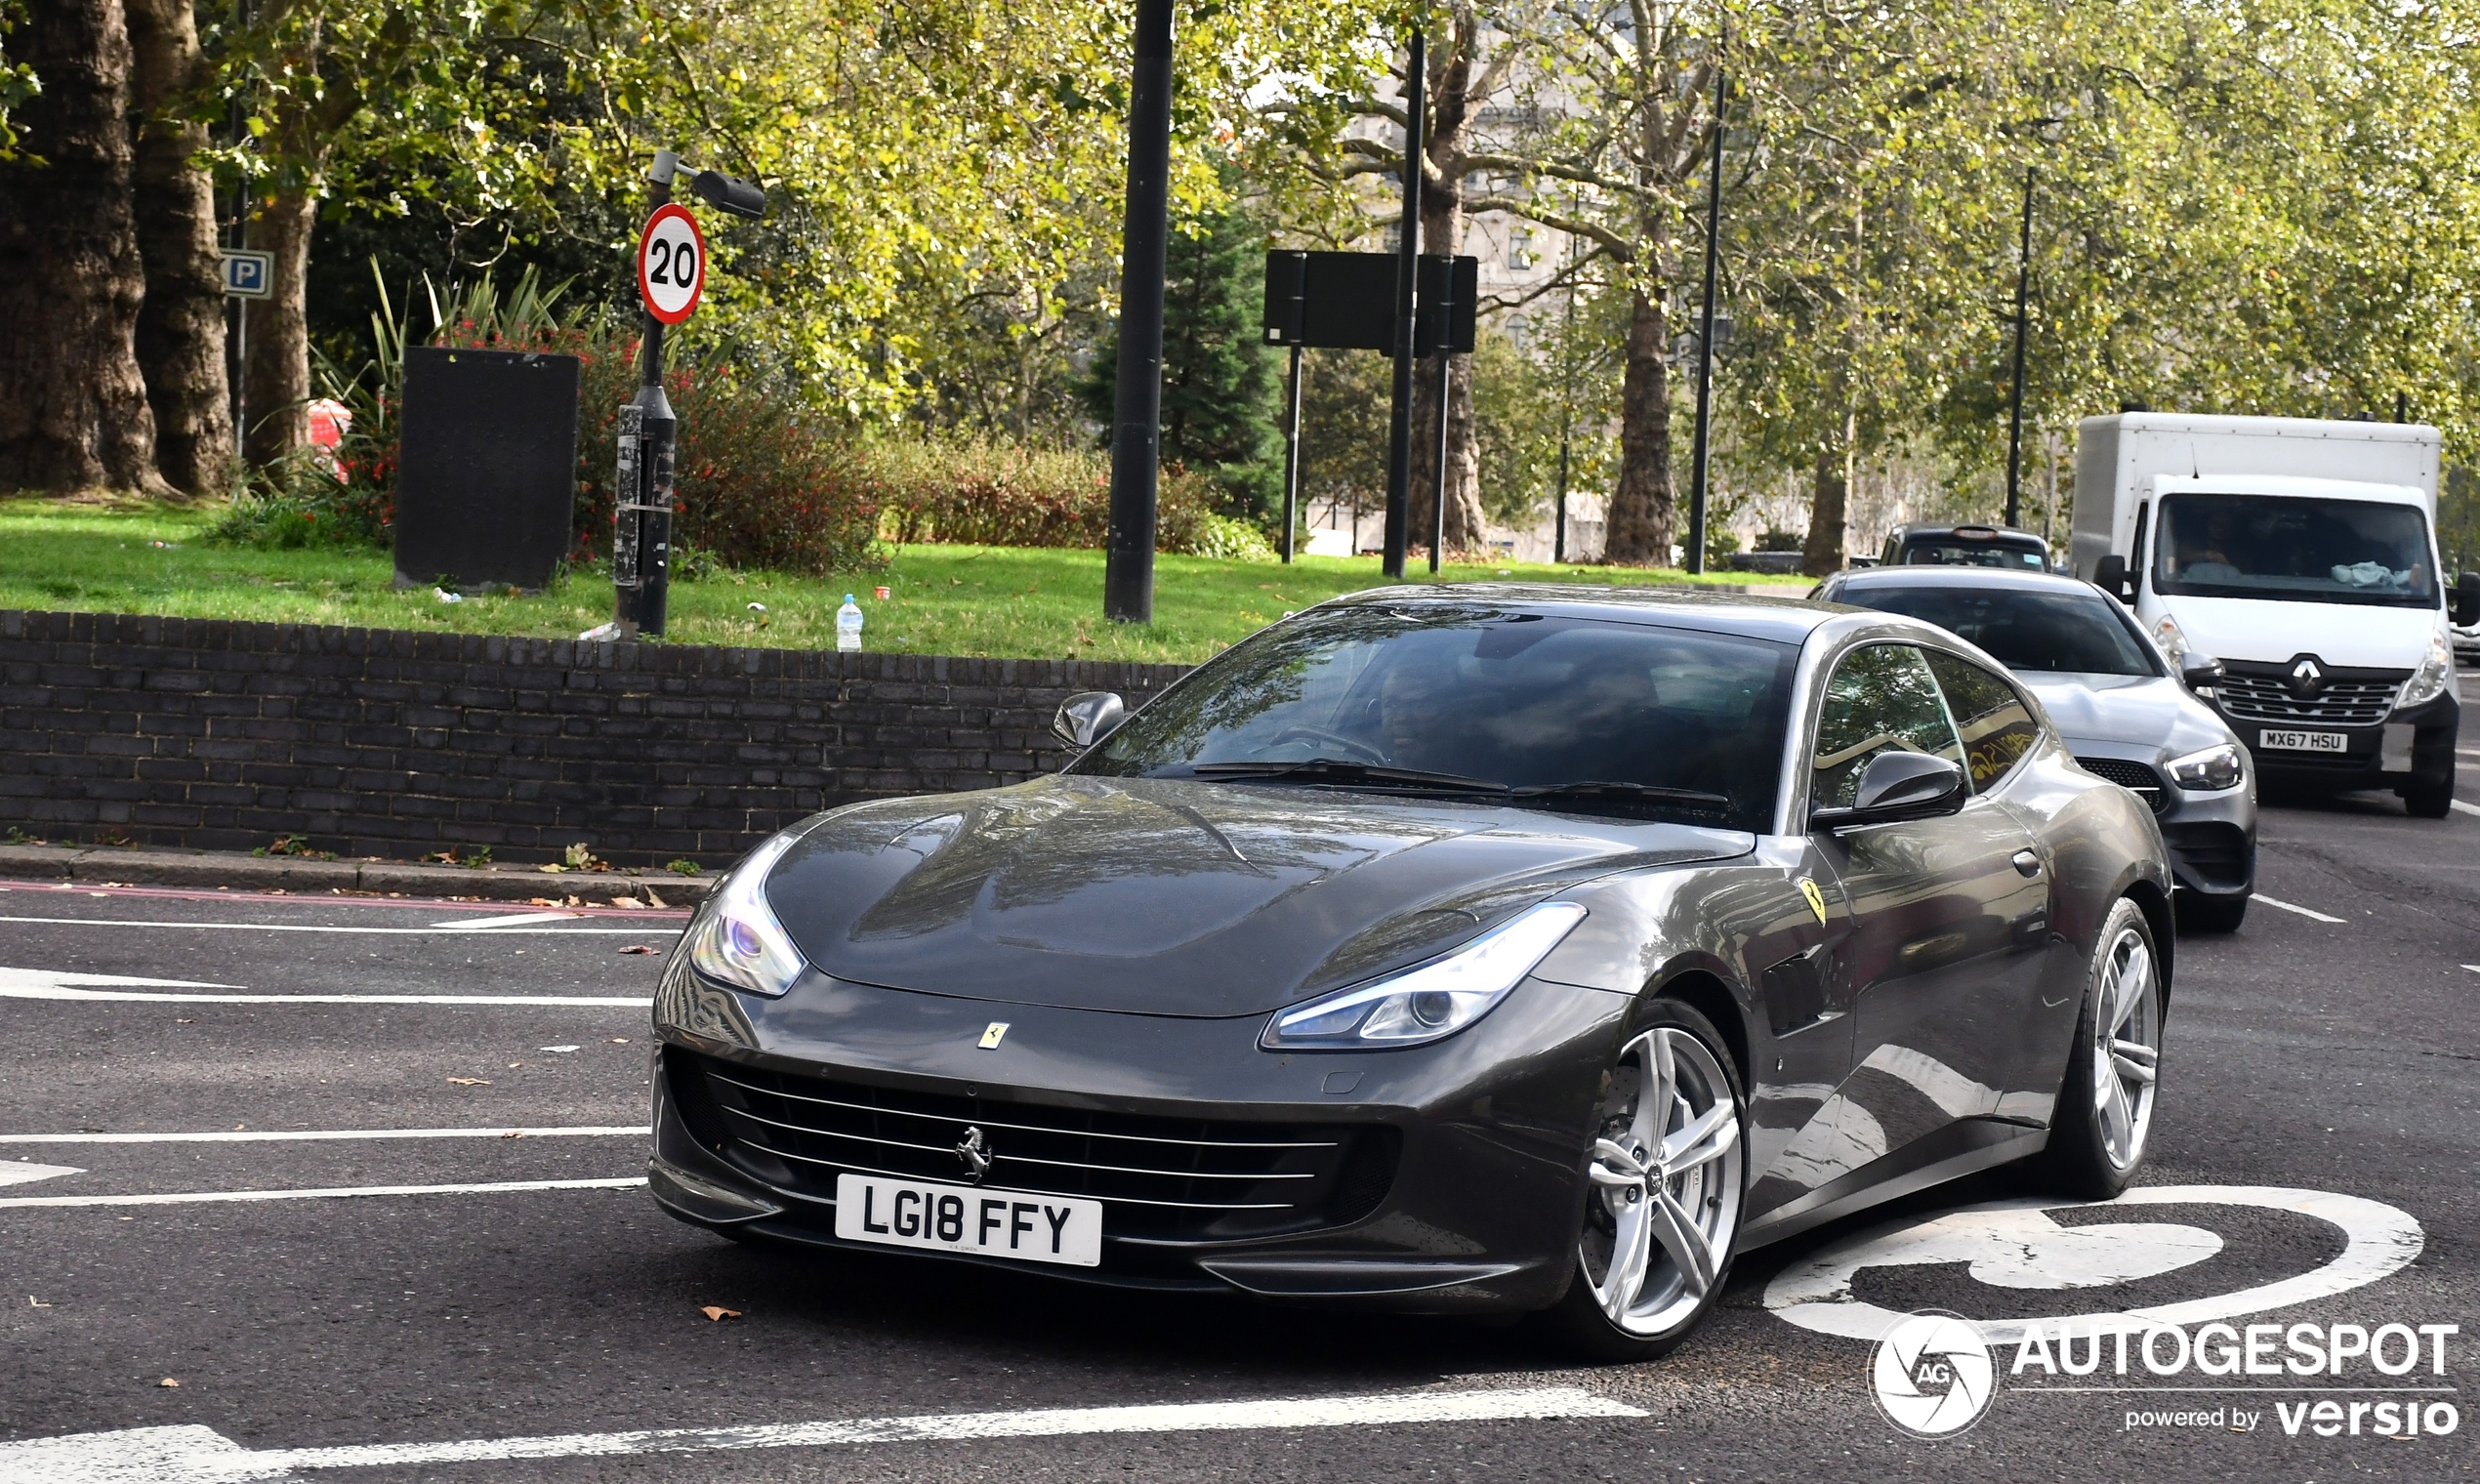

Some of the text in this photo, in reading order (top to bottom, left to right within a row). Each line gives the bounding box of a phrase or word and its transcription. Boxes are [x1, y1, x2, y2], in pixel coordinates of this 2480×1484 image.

[236, 261, 257, 285] P
[650, 237, 695, 289] 20
[2266, 732, 2340, 749] MX67 HSU
[863, 1185, 1071, 1254] LG18 FFY
